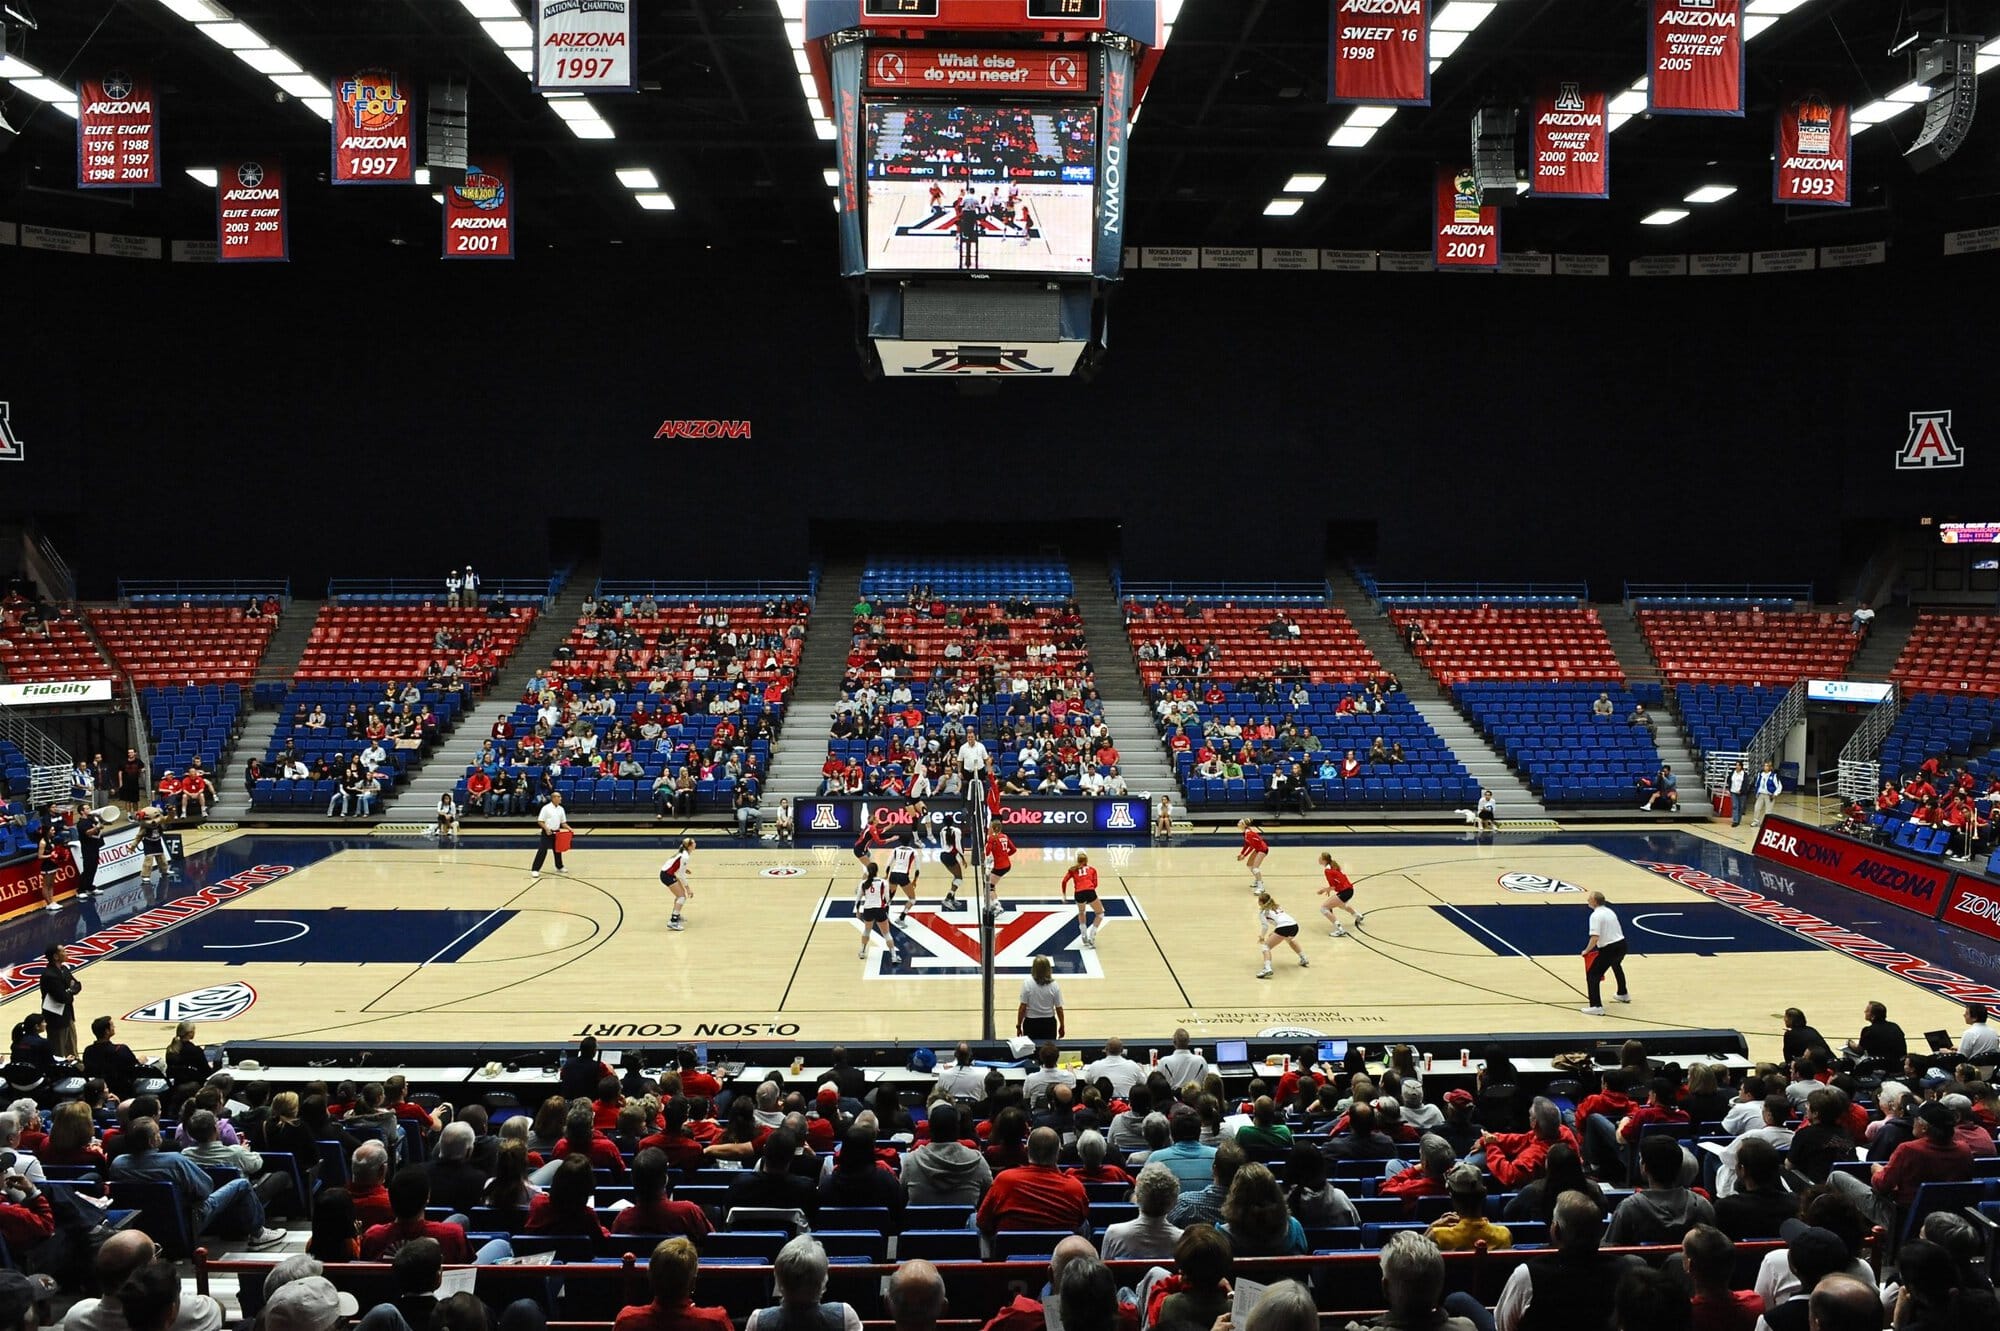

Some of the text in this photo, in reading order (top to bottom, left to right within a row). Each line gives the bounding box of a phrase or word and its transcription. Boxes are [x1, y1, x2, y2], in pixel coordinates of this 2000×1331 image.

[582, 1, 624, 12] CHAMPIONS
[1341, 0, 1421, 15] ARIZONA
[1658, 10, 1736, 27] ARIZONA
[544, 32, 625, 47] ARIZONA
[1341, 27, 1418, 42] SWEET 16
[1666, 33, 1727, 45] ROUND OF
[1341, 47, 1375, 60] 1998
[1669, 44, 1724, 56] SIXTEEN
[938, 53, 1015, 68] What else
[1658, 57, 1692, 71] 2005
[557, 58, 614, 78] 1997
[924, 67, 1029, 84] do you need?
[85, 101, 151, 114] ARIZONA
[1538, 113, 1602, 126] ARIZONA
[84, 125, 151, 135] ELITE EIGHT
[1547, 132, 1590, 141] QUARTER
[88, 140, 149, 151] 1976 1988
[340, 137, 407, 149] ARIZONA
[1553, 141, 1586, 149] FINALS
[88, 154, 150, 166] 1994 1997
[1538, 151, 1600, 163] 2000 2002
[349, 157, 399, 174] 1997
[1538, 165, 1566, 176] 2005
[1783, 157, 1844, 171] ARIZONA
[88, 168, 149, 180] 1998 2001
[1104, 145, 1120, 233] DOWN
[1791, 177, 1835, 195] 1993
[223, 189, 279, 200] ARIZONA
[222, 208, 280, 218] ELITE EIGHT
[225, 222, 279, 233] 2003 2005
[450, 218, 507, 229] ARIZONA
[1440, 224, 1494, 236] ARIZONA
[225, 235, 249, 245] 2011
[457, 236, 499, 251] 2001
[1446, 242, 1486, 258] 2001
[653, 420, 752, 439] ARIZONA
[1895, 409, 1964, 469] A
[22, 684, 91, 696] Fidelity
[1760, 828, 1938, 901] BEAR DOWN ARIZONA
[0, 865, 76, 902] LLS FAGO
[1629, 860, 1832, 927] ARIZONA
[104, 864, 295, 942] WILDCATS
[1954, 892, 2000, 926] ZON
[573, 1023, 800, 1037] OLSON COURT
